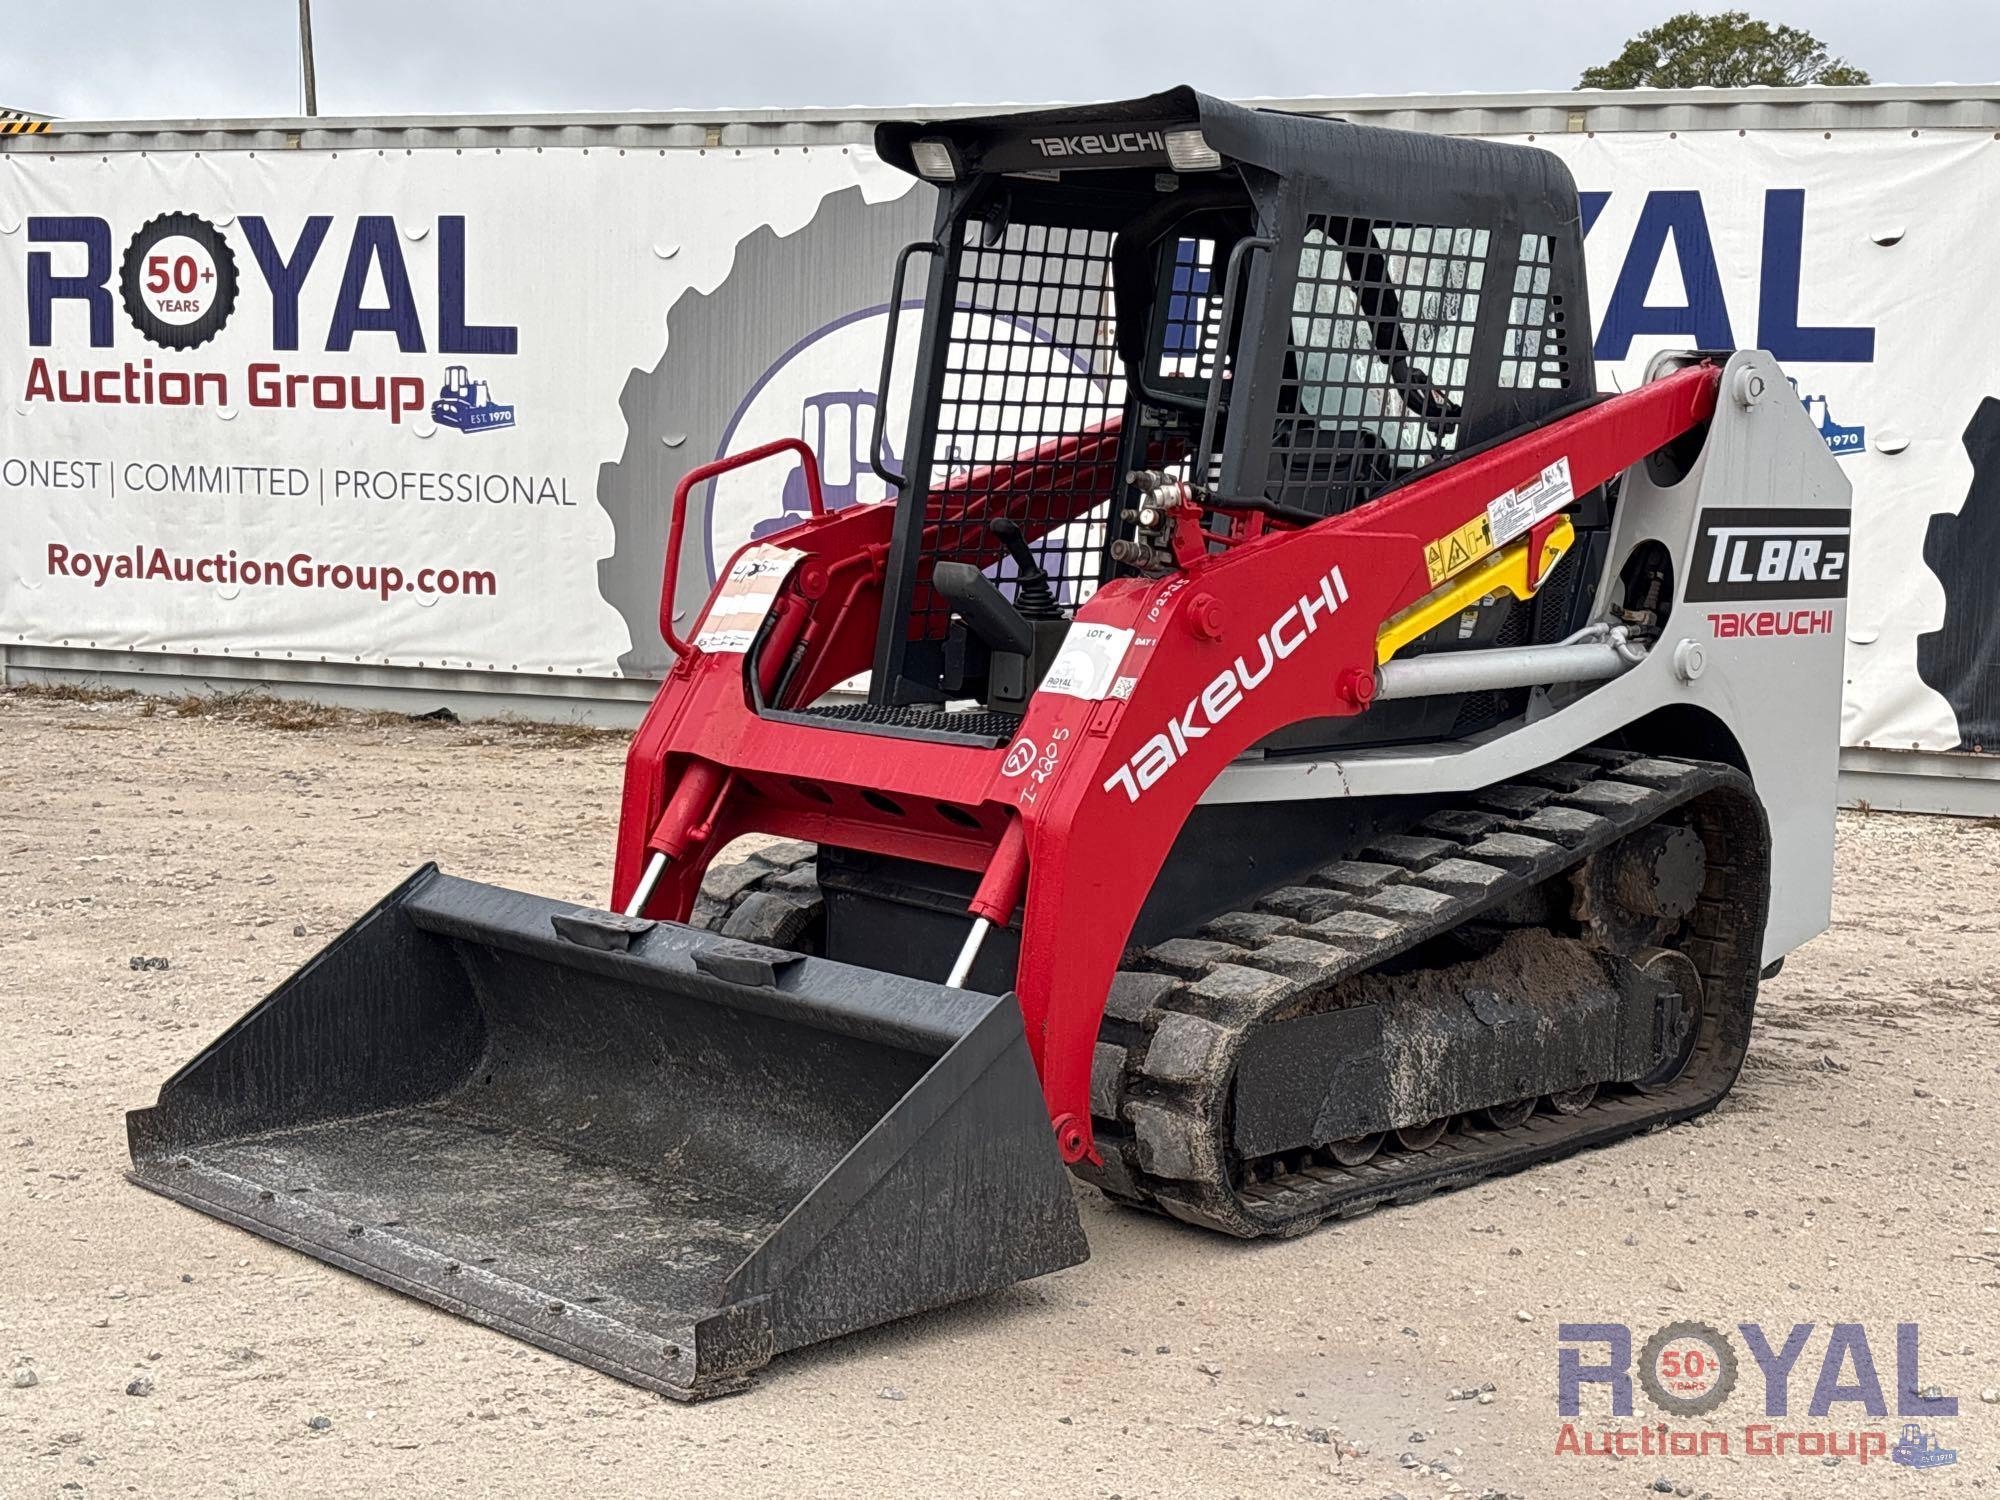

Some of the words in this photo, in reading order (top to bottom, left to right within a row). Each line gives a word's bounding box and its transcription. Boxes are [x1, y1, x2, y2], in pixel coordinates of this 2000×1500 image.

[1031, 131, 1164, 157] TAKEUCHI
[27, 211, 518, 355] ROYAL
[146, 255, 214, 294] 50+
[1578, 188, 1876, 363] AL
[156, 299, 200, 313] YEARS
[24, 357, 228, 406] Auction
[248, 363, 425, 425] Group
[489, 410, 511, 422] 1970
[1825, 433, 1858, 446] 1970
[2, 459, 102, 489] ONEST
[124, 462, 309, 496] COMMITTED
[335, 470, 577, 506] PROFESSIONAL
[48, 543, 496, 601] RoyalAuctionGroup.com
[1707, 527, 1850, 583] TL8R2
[1086, 629, 1104, 639] LOT
[1706, 609, 1833, 638] TAKEUCHI
[1134, 637, 1151, 647] DAY
[1046, 677, 1072, 687] ROYAL
[1103, 564, 1349, 804] TAKEUCHI
